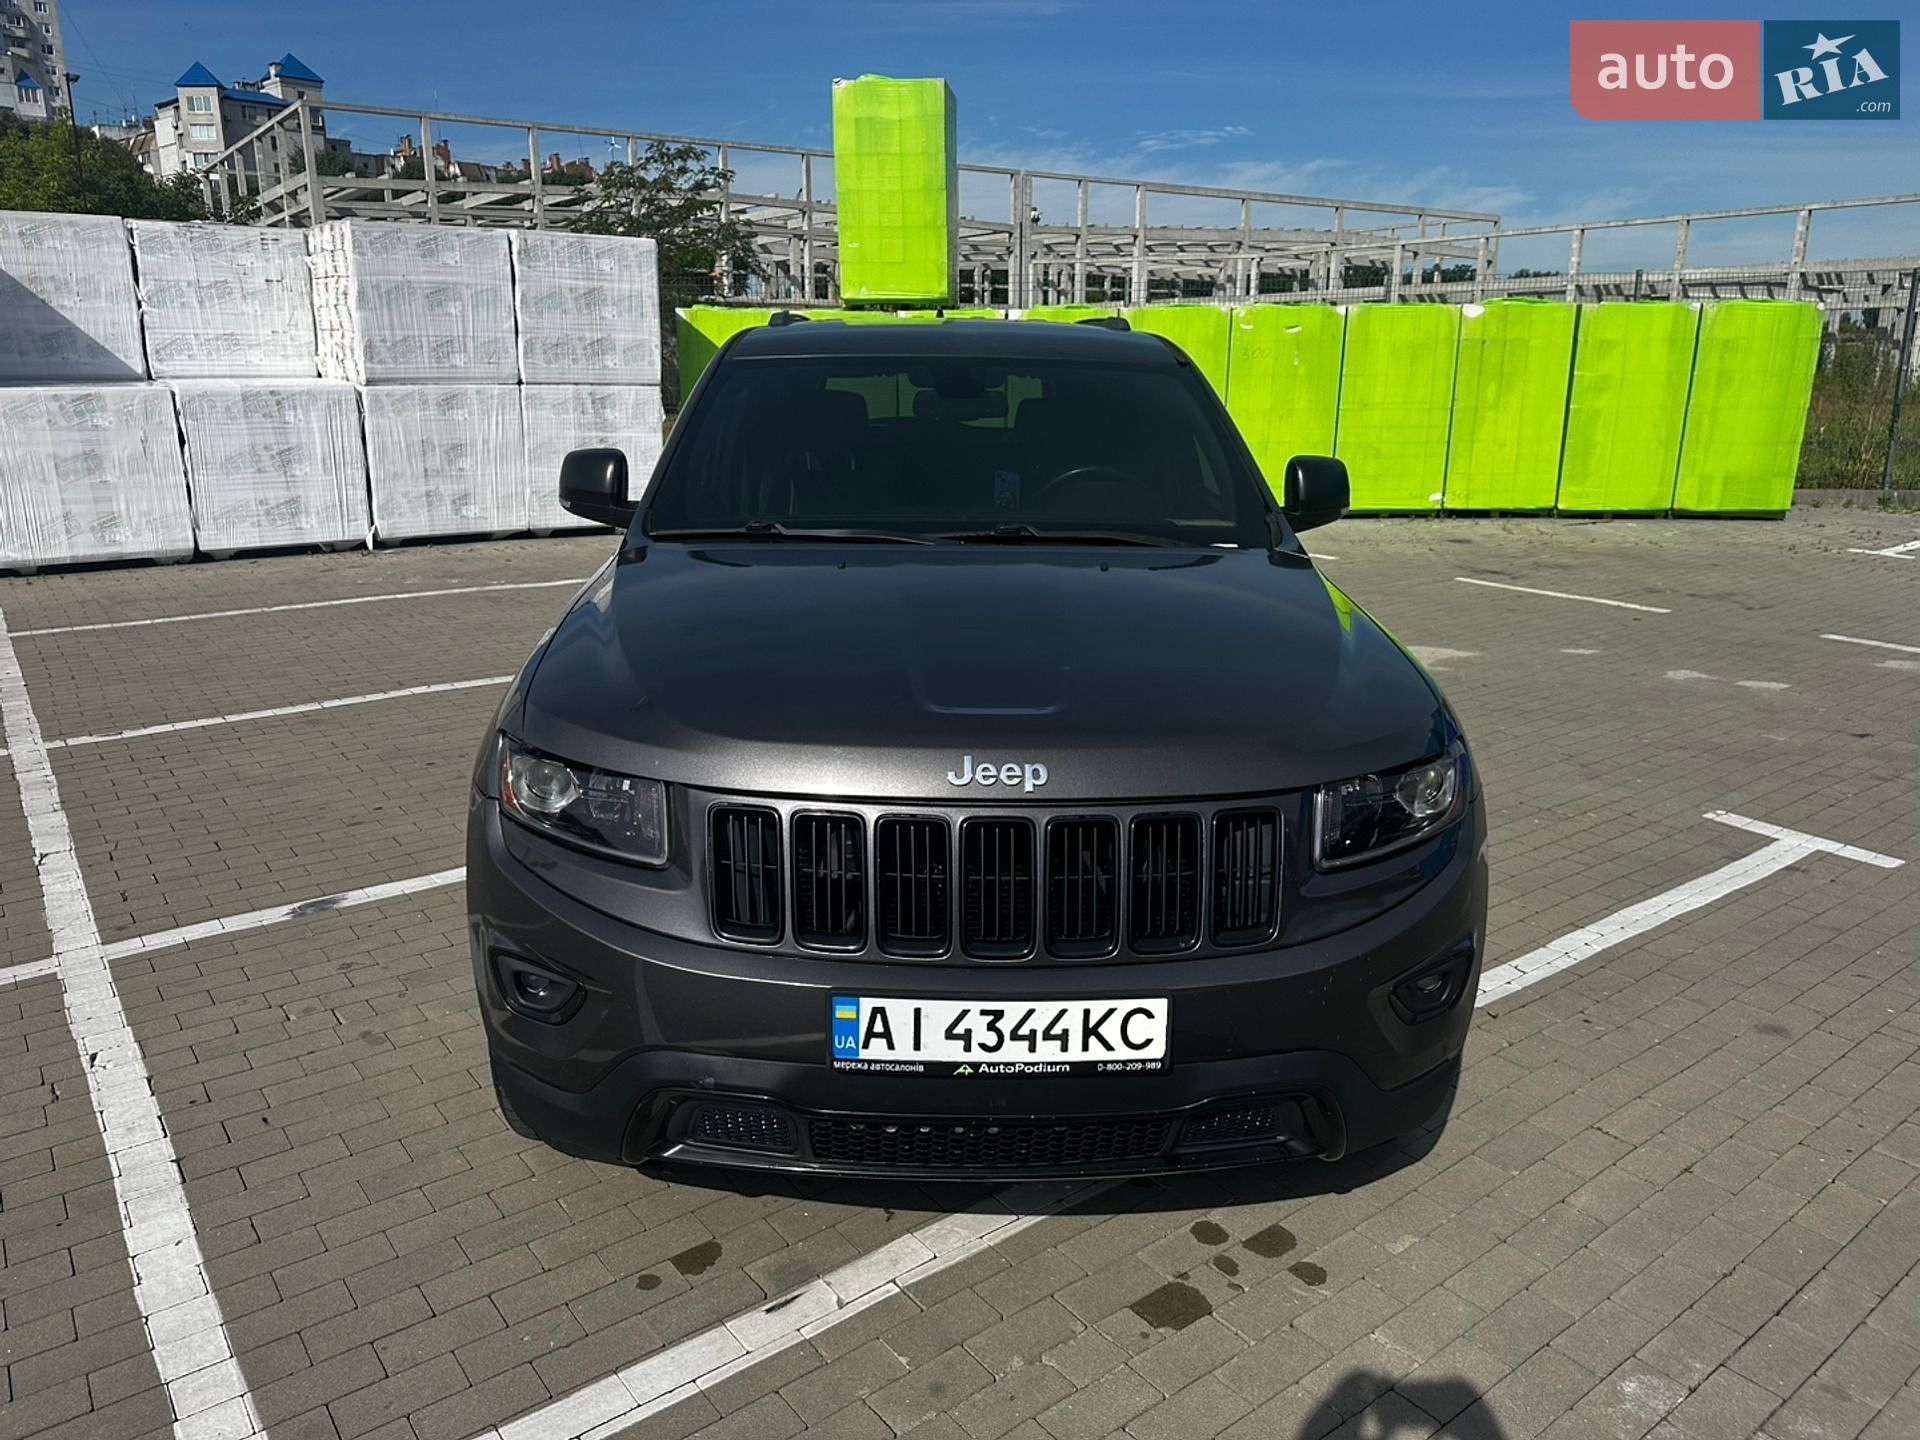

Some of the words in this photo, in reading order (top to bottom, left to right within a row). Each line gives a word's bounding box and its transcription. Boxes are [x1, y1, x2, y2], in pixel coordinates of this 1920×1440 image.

[947, 755, 1049, 794] Jeep
[834, 1035, 857, 1050] UA
[832, 1060, 869, 1071] мережа
[869, 1062, 925, 1073] автосалонів
[978, 1062, 1071, 1074] AutoPodium
[1097, 1061, 1162, 1072] 0-800-209-989
